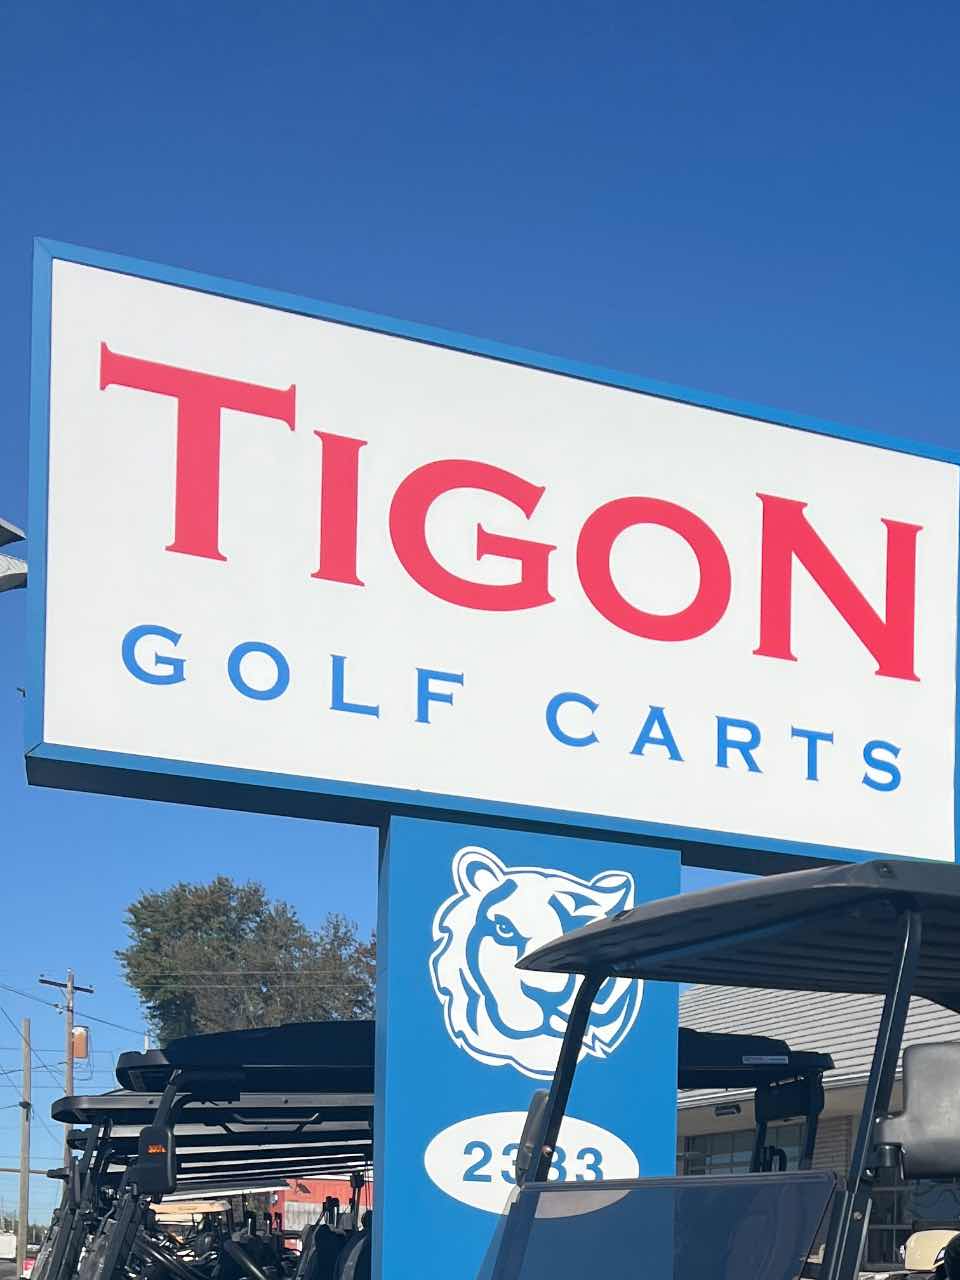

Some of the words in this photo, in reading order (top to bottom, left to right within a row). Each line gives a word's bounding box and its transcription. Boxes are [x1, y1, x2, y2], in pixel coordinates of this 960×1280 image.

[99, 340, 923, 682] TIGON
[120, 623, 464, 724] GOLF
[544, 691, 902, 792] CARTS
